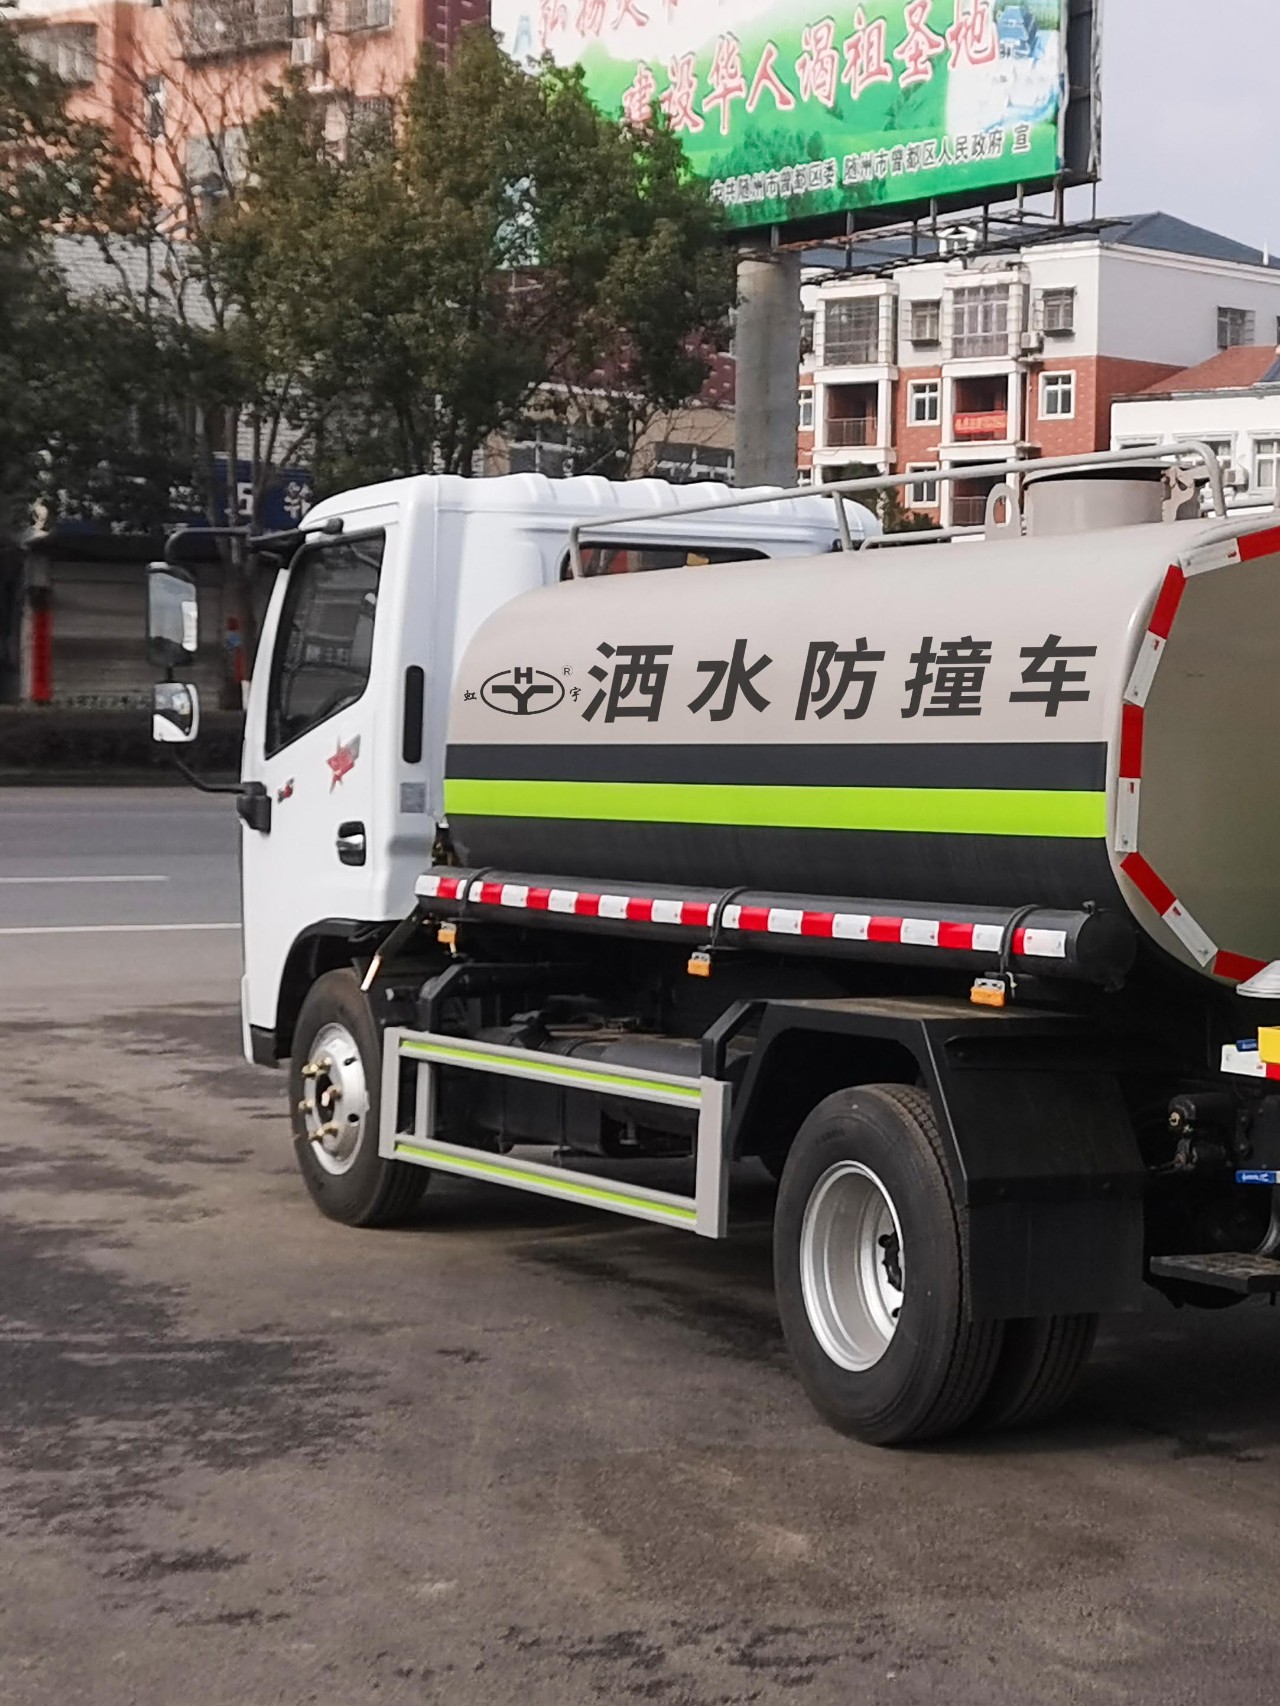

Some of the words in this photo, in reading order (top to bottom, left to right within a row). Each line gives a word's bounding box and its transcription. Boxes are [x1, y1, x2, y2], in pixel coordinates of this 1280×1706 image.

[622, 0, 999, 134] 建设华人谒祖圣地
[1012, 123, 1031, 152] 宣
[581, 633, 1099, 724] 洒水防撞车
